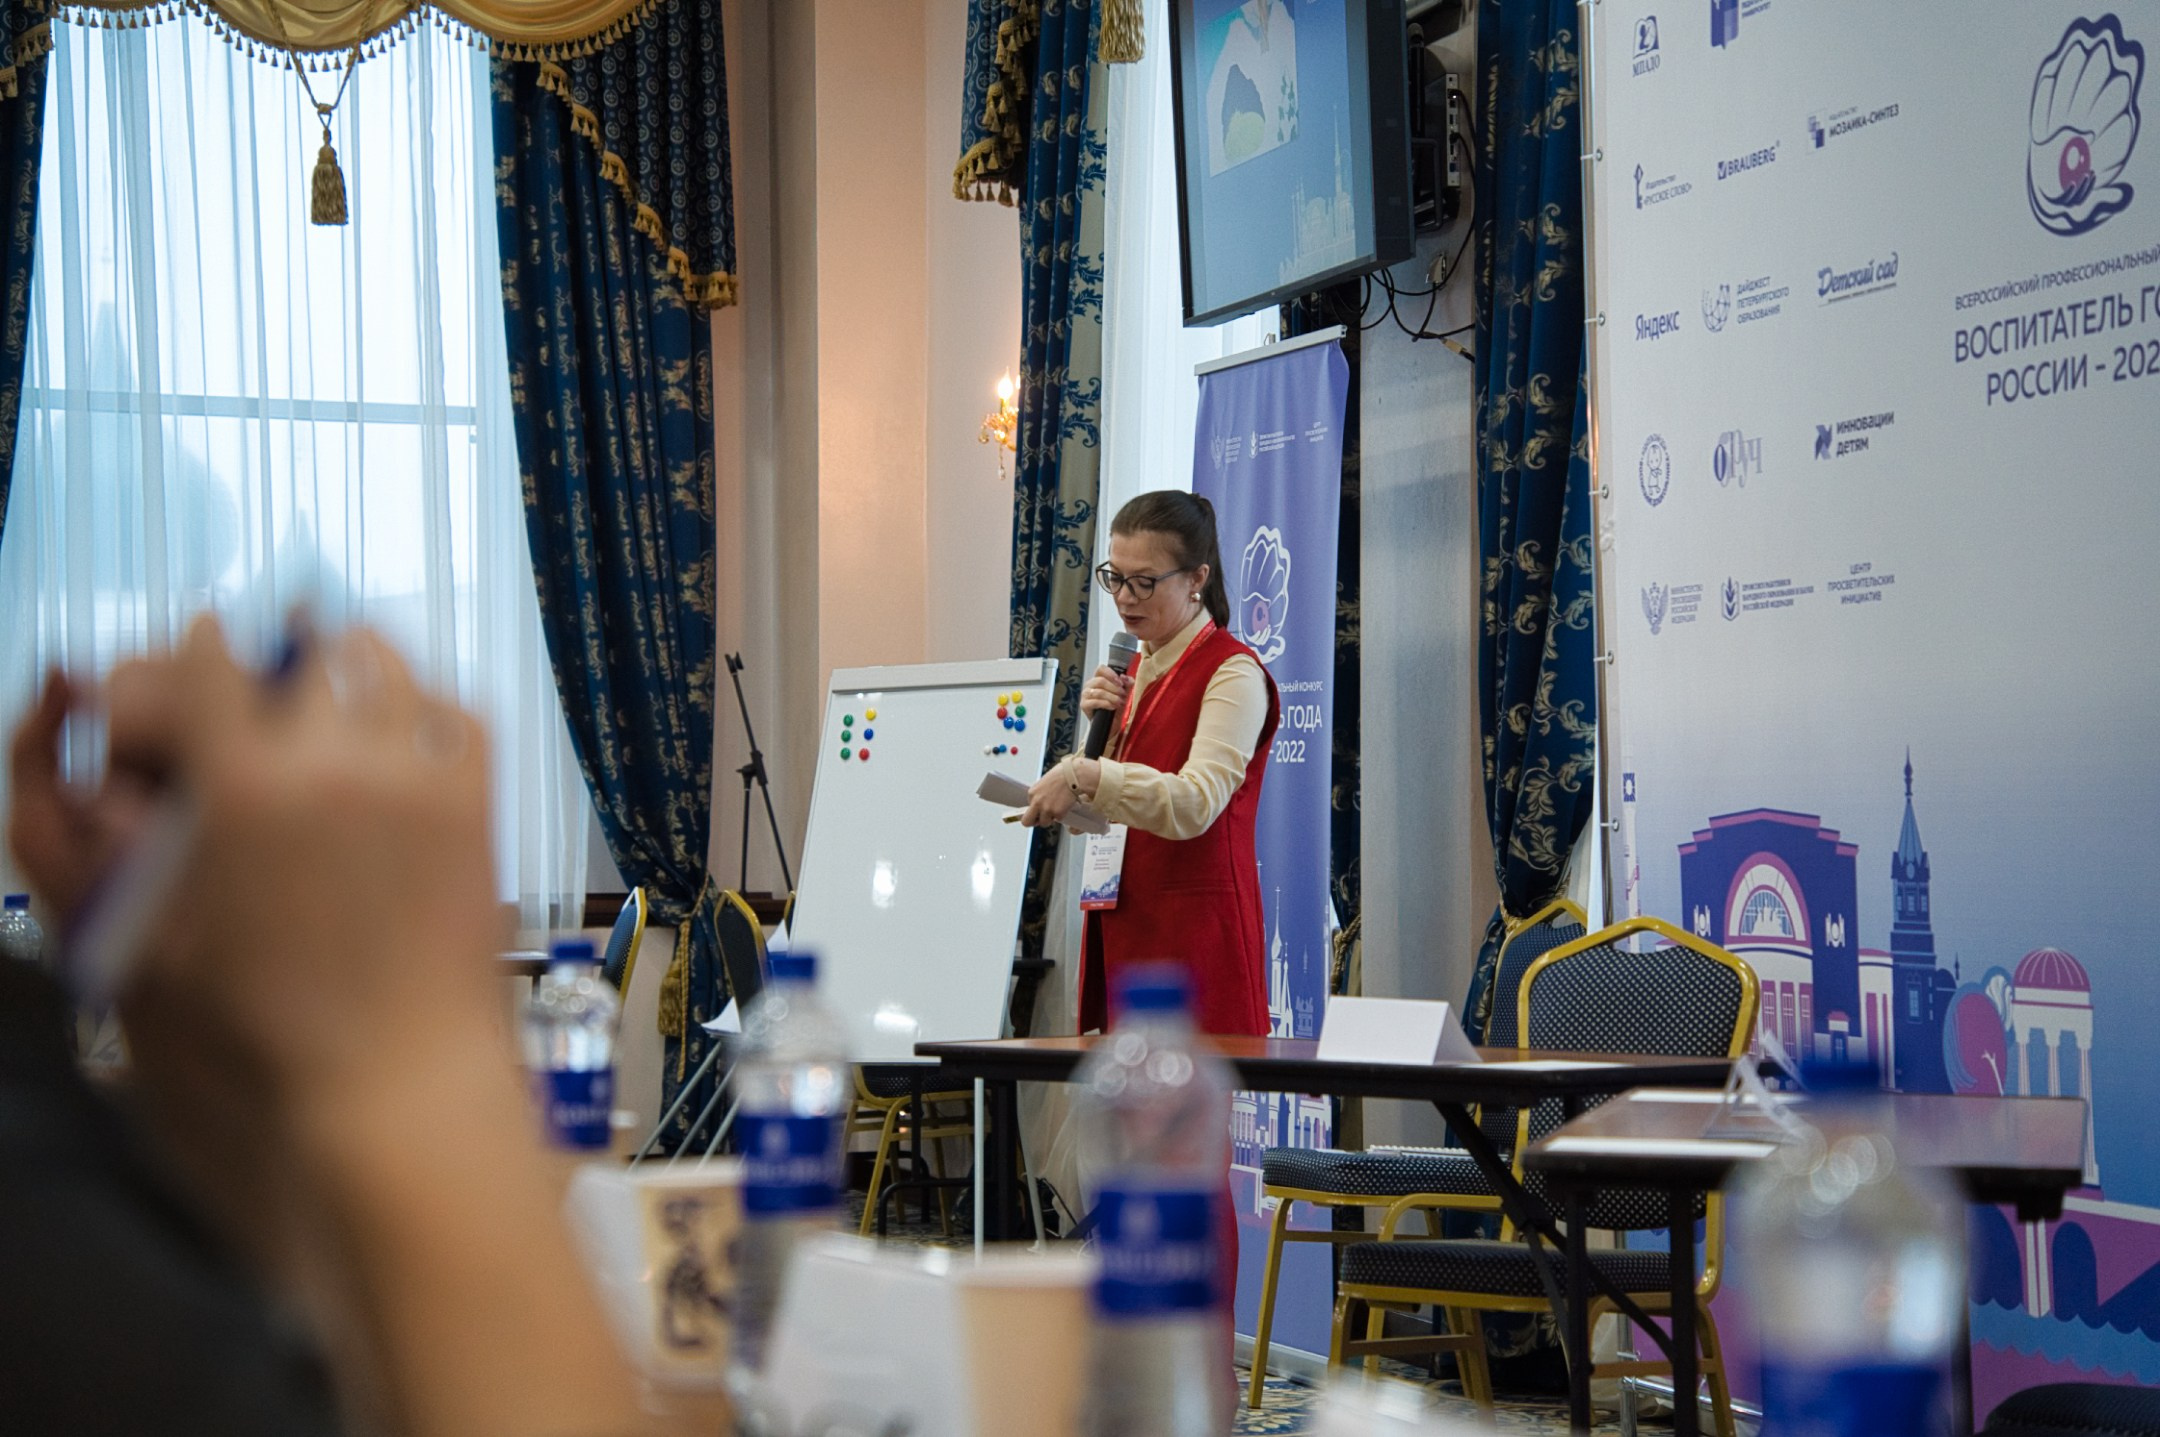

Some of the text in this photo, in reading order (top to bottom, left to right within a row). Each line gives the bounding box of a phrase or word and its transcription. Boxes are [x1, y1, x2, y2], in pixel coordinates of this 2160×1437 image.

[1728, 146, 1775, 176] BRAUBERG
[1955, 274, 2041, 310] ВСЕРОССИЙСКИЙ
[1635, 310, 1680, 341] Яндекс
[1955, 293, 2134, 363] ВОСПИТАТЕЛЬ
[1987, 354, 2088, 406] РОССИИ
[1287, 704, 1323, 733] ГОДА
[1275, 740, 1305, 763] 2022
